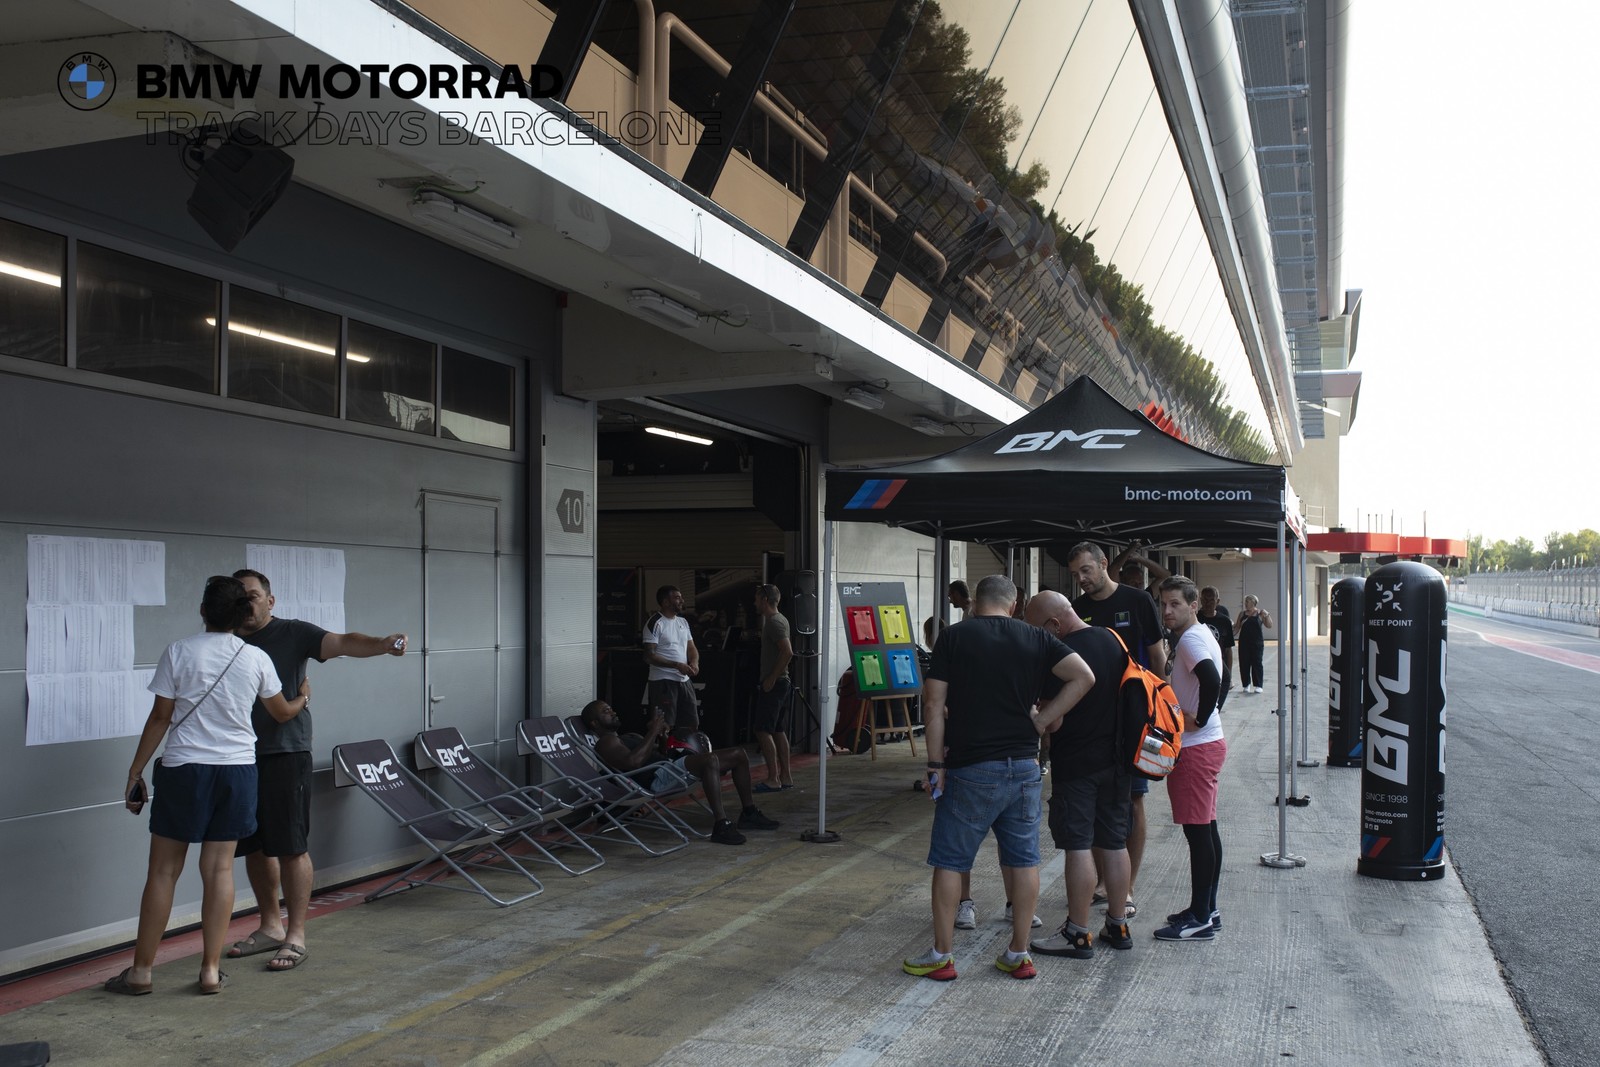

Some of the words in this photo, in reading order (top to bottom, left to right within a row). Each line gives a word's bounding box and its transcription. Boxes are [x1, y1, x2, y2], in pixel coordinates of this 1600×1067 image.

[993, 428, 1141, 455] BMC
[1124, 486, 1252, 501] bmc-moto.com
[564, 497, 582, 526] 10
[843, 586, 861, 595] BMC
[1368, 619, 1385, 627] MEET
[1387, 619, 1413, 627] POINT
[1366, 638, 1411, 786] BMC
[535, 732, 570, 753] BMC
[436, 744, 470, 767] BMC
[356, 759, 399, 783] BMC
[1365, 792, 1386, 802] SINCE
[1387, 795, 1408, 804] 1998
